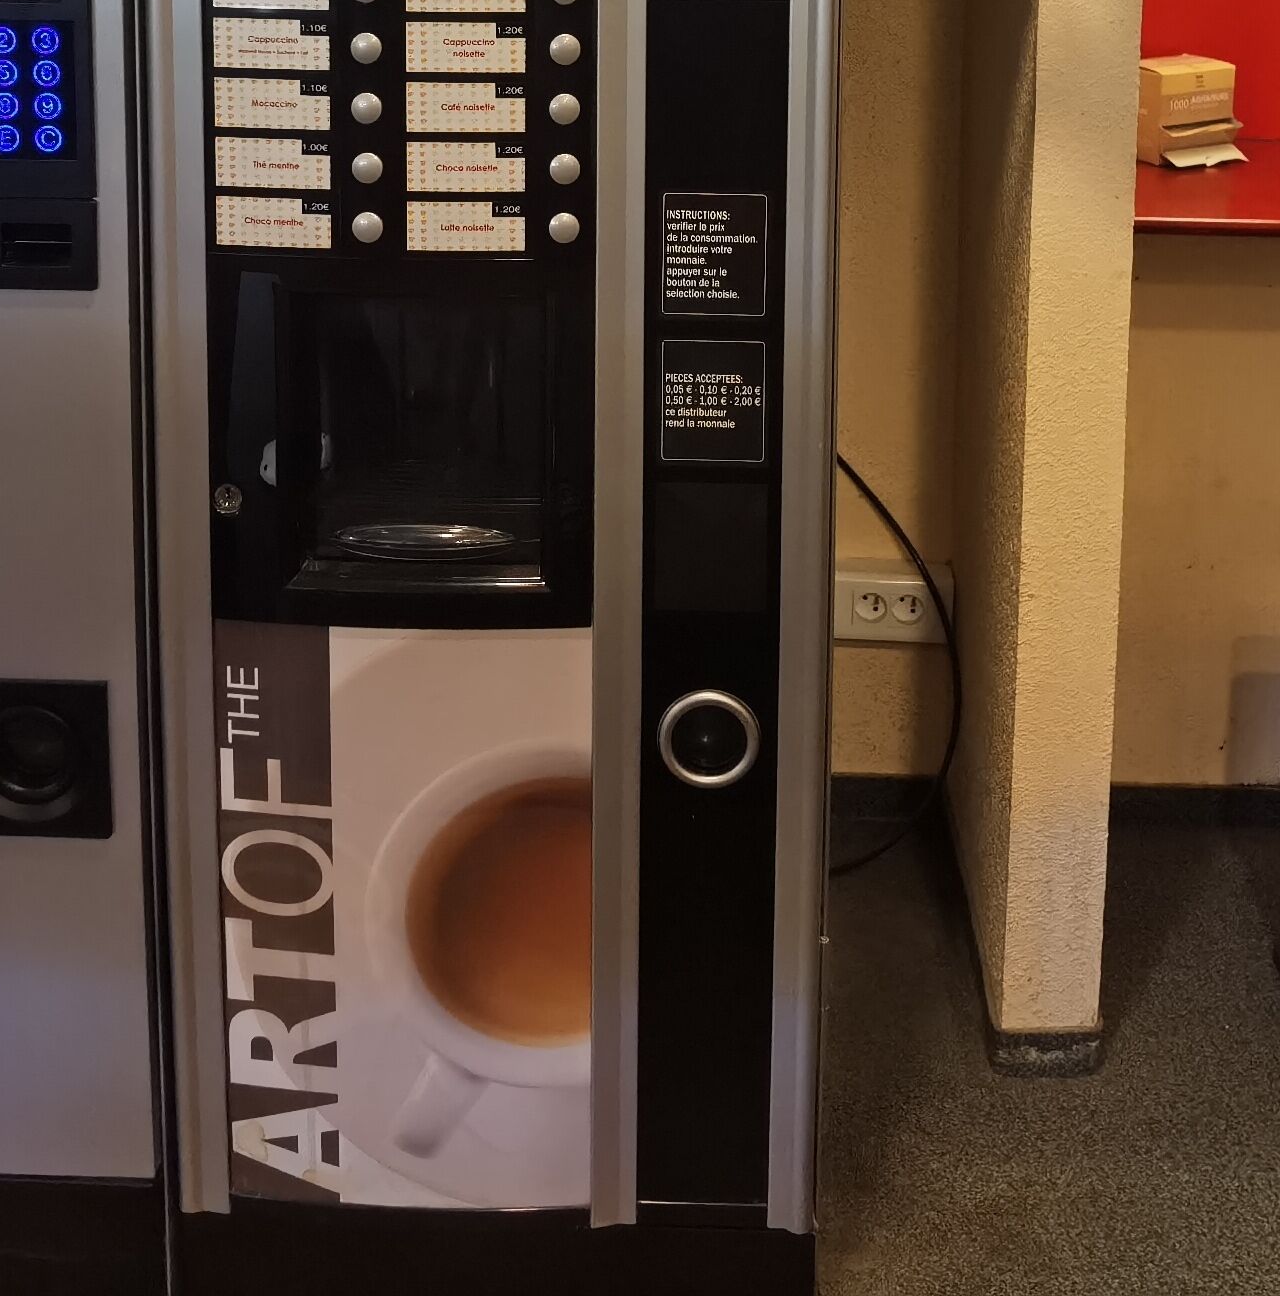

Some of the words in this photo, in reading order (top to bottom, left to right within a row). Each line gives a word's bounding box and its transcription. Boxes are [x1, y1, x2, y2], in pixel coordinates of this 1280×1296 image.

[301, 24, 327, 33] 1.10€
[497, 26, 524, 35] 1.20€
[248, 35, 299, 46] Cappuccino
[443, 38, 495, 48] Cappuccino
[453, 50, 485, 58] noisette
[301, 84, 328, 92] 1.10€
[497, 87, 524, 95] 1.20€
[252, 99, 298, 108] Mocaccino
[441, 102, 461, 111] Café
[463, 103, 496, 112] noisette
[303, 143, 328, 152] 1.00€
[497, 146, 524, 154] 1.20€
[253, 160, 267, 169] Thé
[269, 161, 300, 170] menthe
[436, 164, 463, 173] Choco
[465, 164, 498, 173] noisette
[303, 202, 330, 211] 1.20€
[494, 205, 521, 214] 1.20€
[666, 209, 731, 220] INSTRUCTIONS:
[244, 216, 271, 226] Choco
[273, 217, 304, 227] menthe
[440, 223, 460, 232] Latte
[462, 223, 495, 232] noisette
[666, 221, 697, 231] verifier
[699, 222, 707, 231] le
[709, 222, 725, 233] prix
[666, 232, 678, 242] de
[680, 232, 689, 242] la
[690, 234, 758, 244] consommation.
[666, 244, 709, 253] introduire
[711, 245, 733, 254] votre
[666, 255, 707, 264] monnaie.
[666, 267, 701, 277] appuyer
[703, 267, 717, 276] sur
[719, 267, 728, 276] le
[666, 277, 697, 287] bouton
[698, 278, 710, 287] de
[712, 278, 720, 287] la
[666, 289, 705, 299] selection
[707, 289, 740, 299] choisie.
[665, 373, 694, 383] PIECES
[695, 374, 743, 384] ACCEPTEES:
[665, 384, 684, 395] 0,05
[699, 385, 718, 395] 0,10
[734, 385, 753, 396] 0,20
[665, 395, 684, 406] 0,50
[699, 396, 718, 406] 1,00
[734, 397, 753, 407] 2,00
[665, 408, 676, 416] ce
[677, 407, 727, 417] distributeur
[665, 418, 685, 428] rend
[686, 418, 695, 428] la
[696, 419, 736, 429] monnaie
[226, 665, 260, 743] THE
[219, 747, 335, 917] OF
[225, 916, 341, 1204] ART
